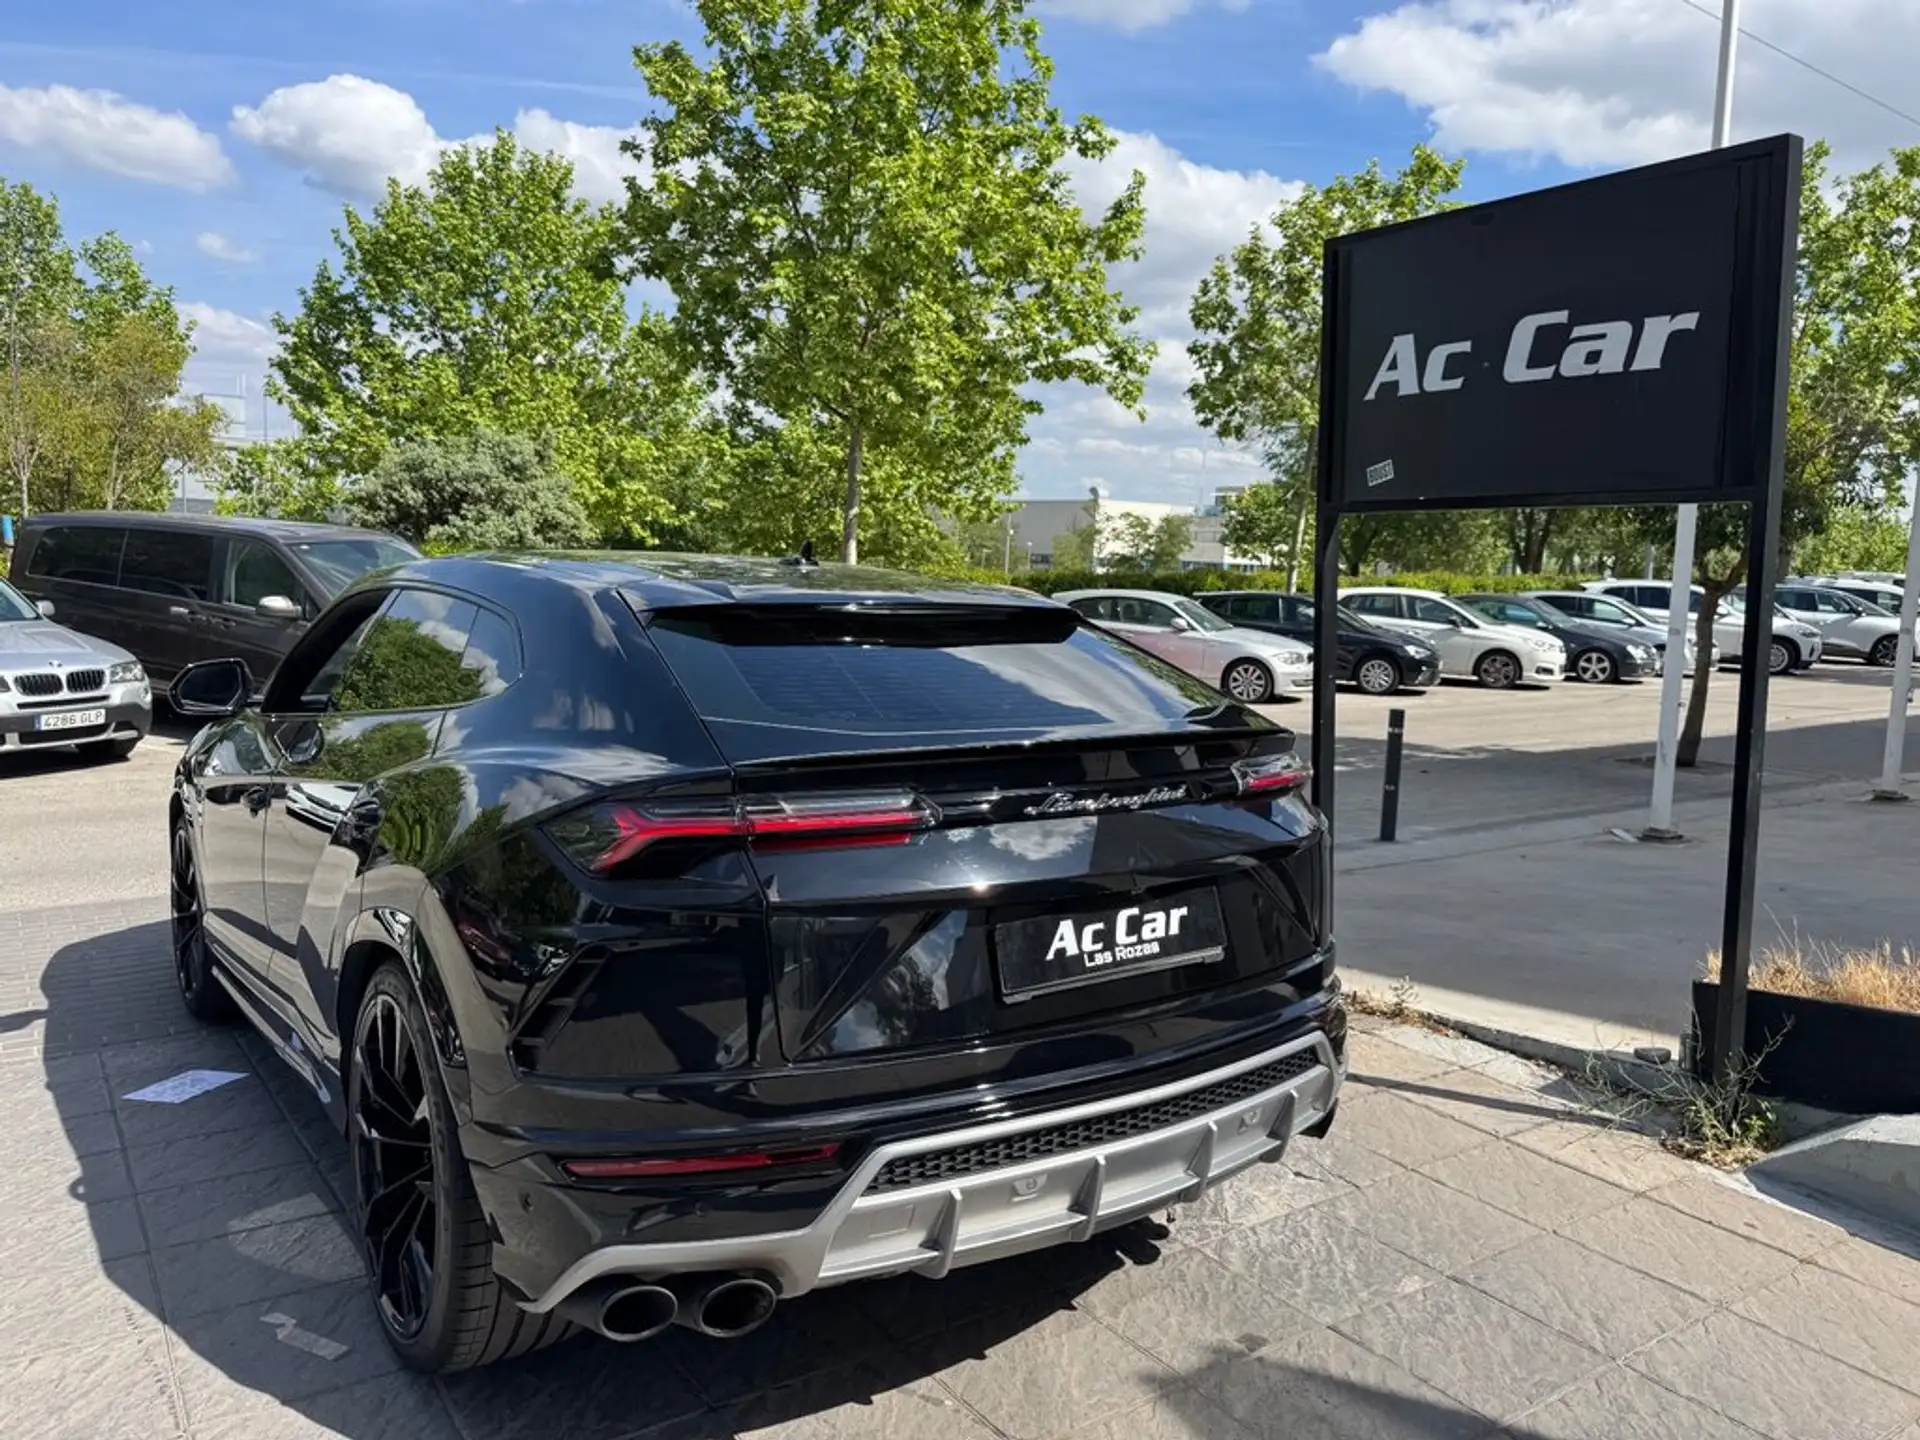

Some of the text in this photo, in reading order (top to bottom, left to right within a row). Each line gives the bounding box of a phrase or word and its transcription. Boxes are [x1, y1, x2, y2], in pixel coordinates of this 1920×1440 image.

[1363, 309, 1701, 401] Ac Car
[43, 713, 76, 728] 4286
[80, 711, 103, 725] GLP
[1024, 784, 1187, 816] Lamborghini
[1045, 906, 1188, 961] Ac Car
[1084, 942, 1161, 967] Las Rozas
